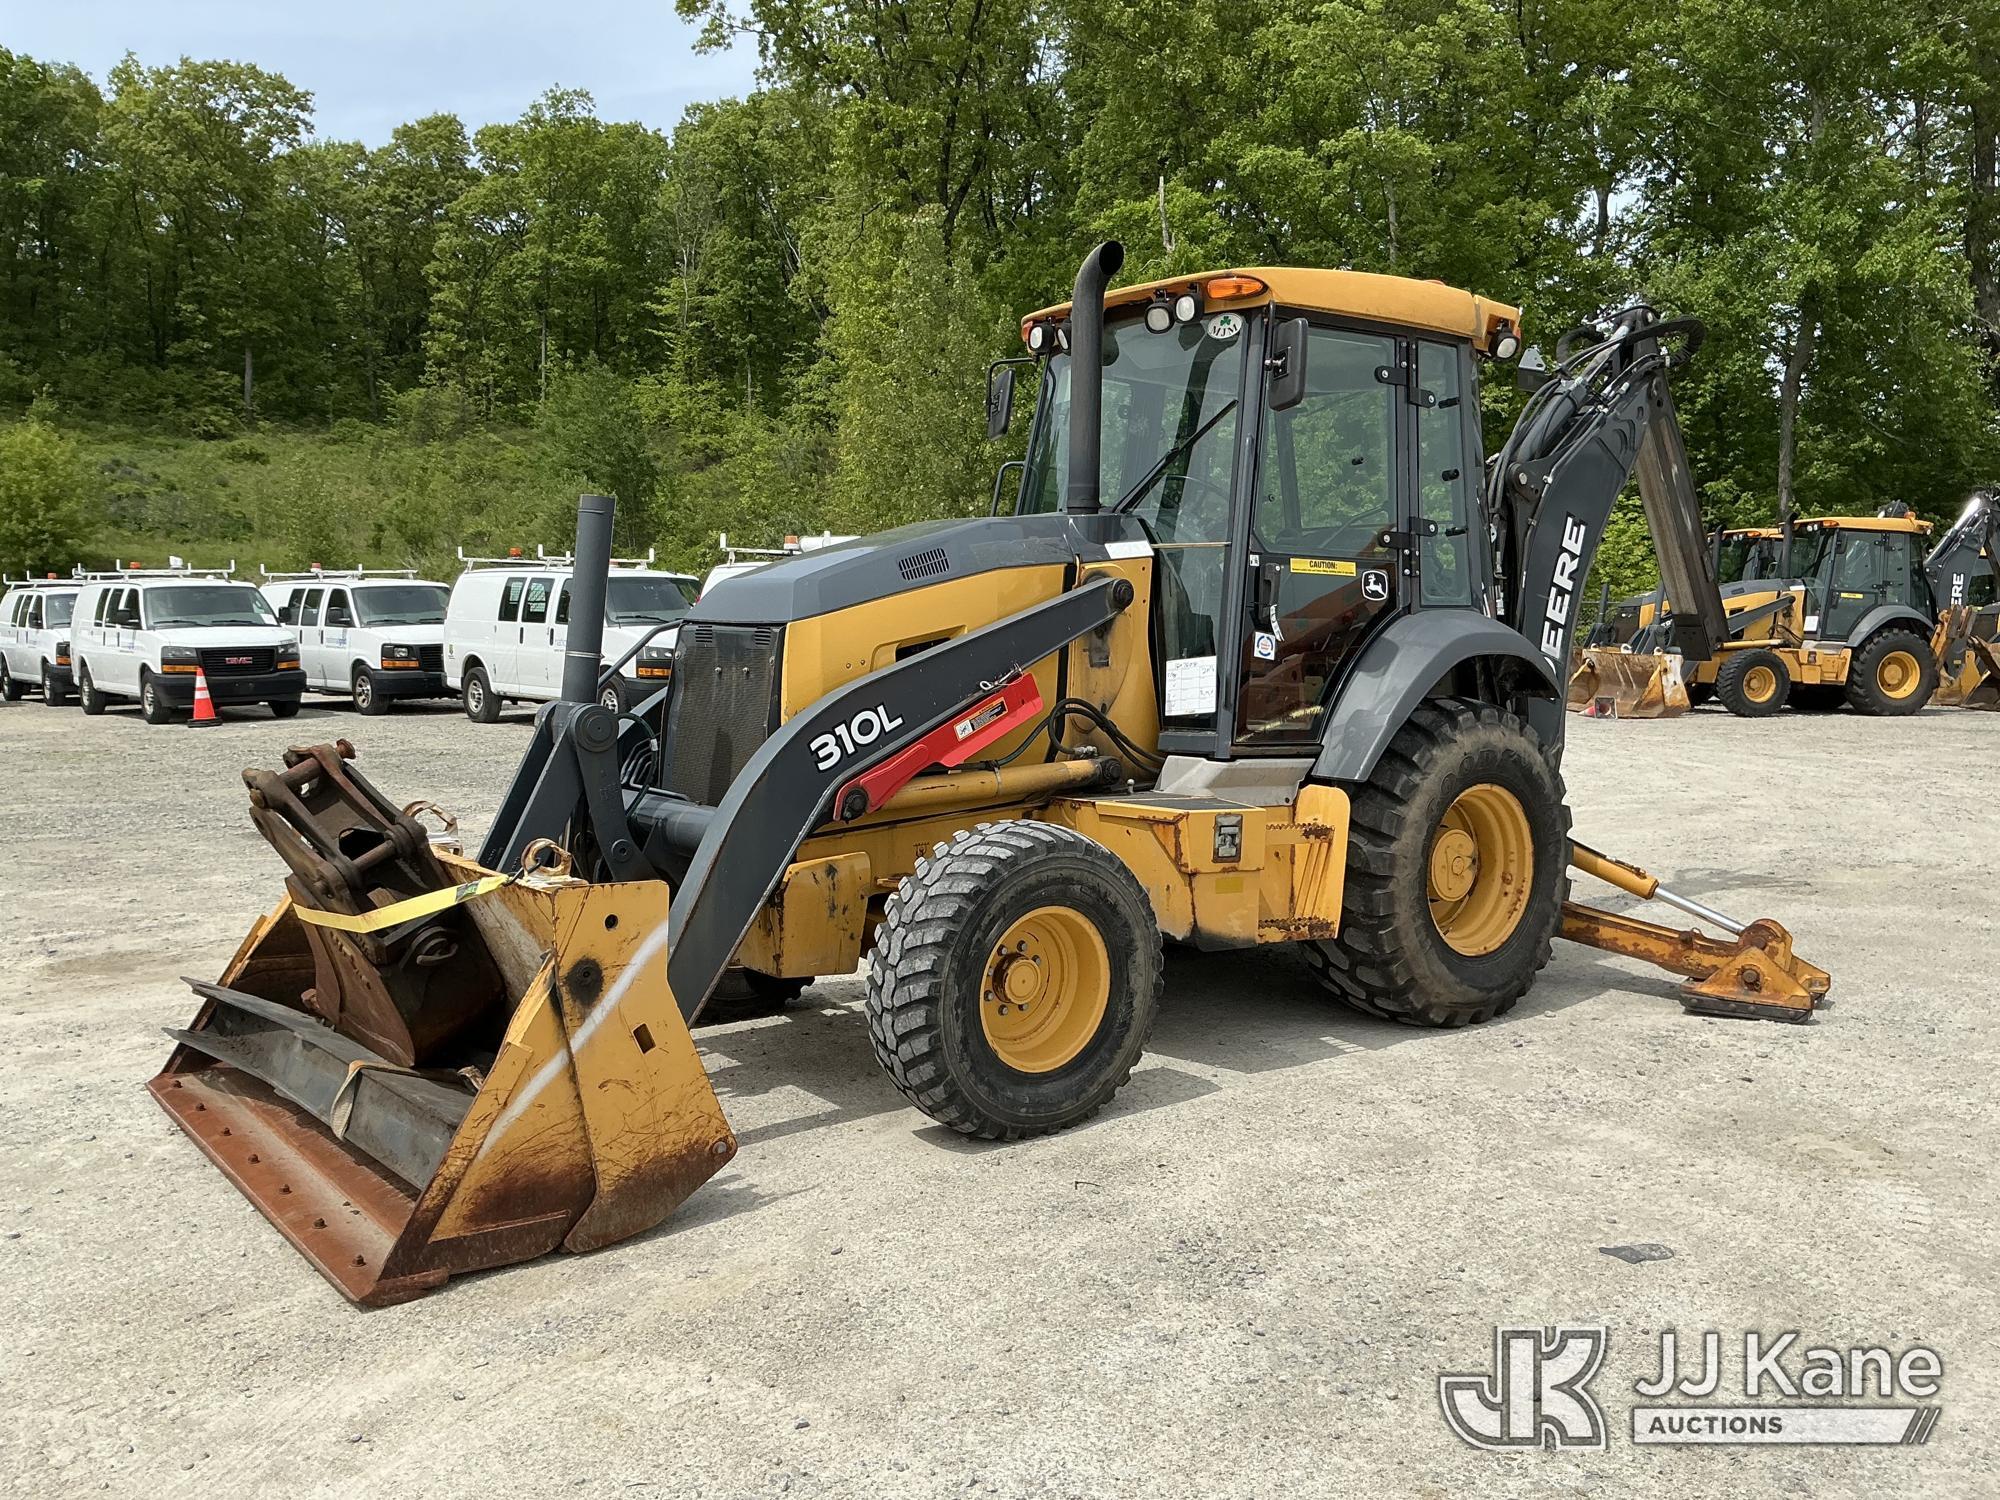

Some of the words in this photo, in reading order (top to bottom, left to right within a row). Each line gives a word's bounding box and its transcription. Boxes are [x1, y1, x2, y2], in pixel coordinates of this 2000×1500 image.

[1213, 323, 1238, 337] MJM
[1309, 560, 1338, 570] CAUTION:
[809, 704, 903, 771] 310L
